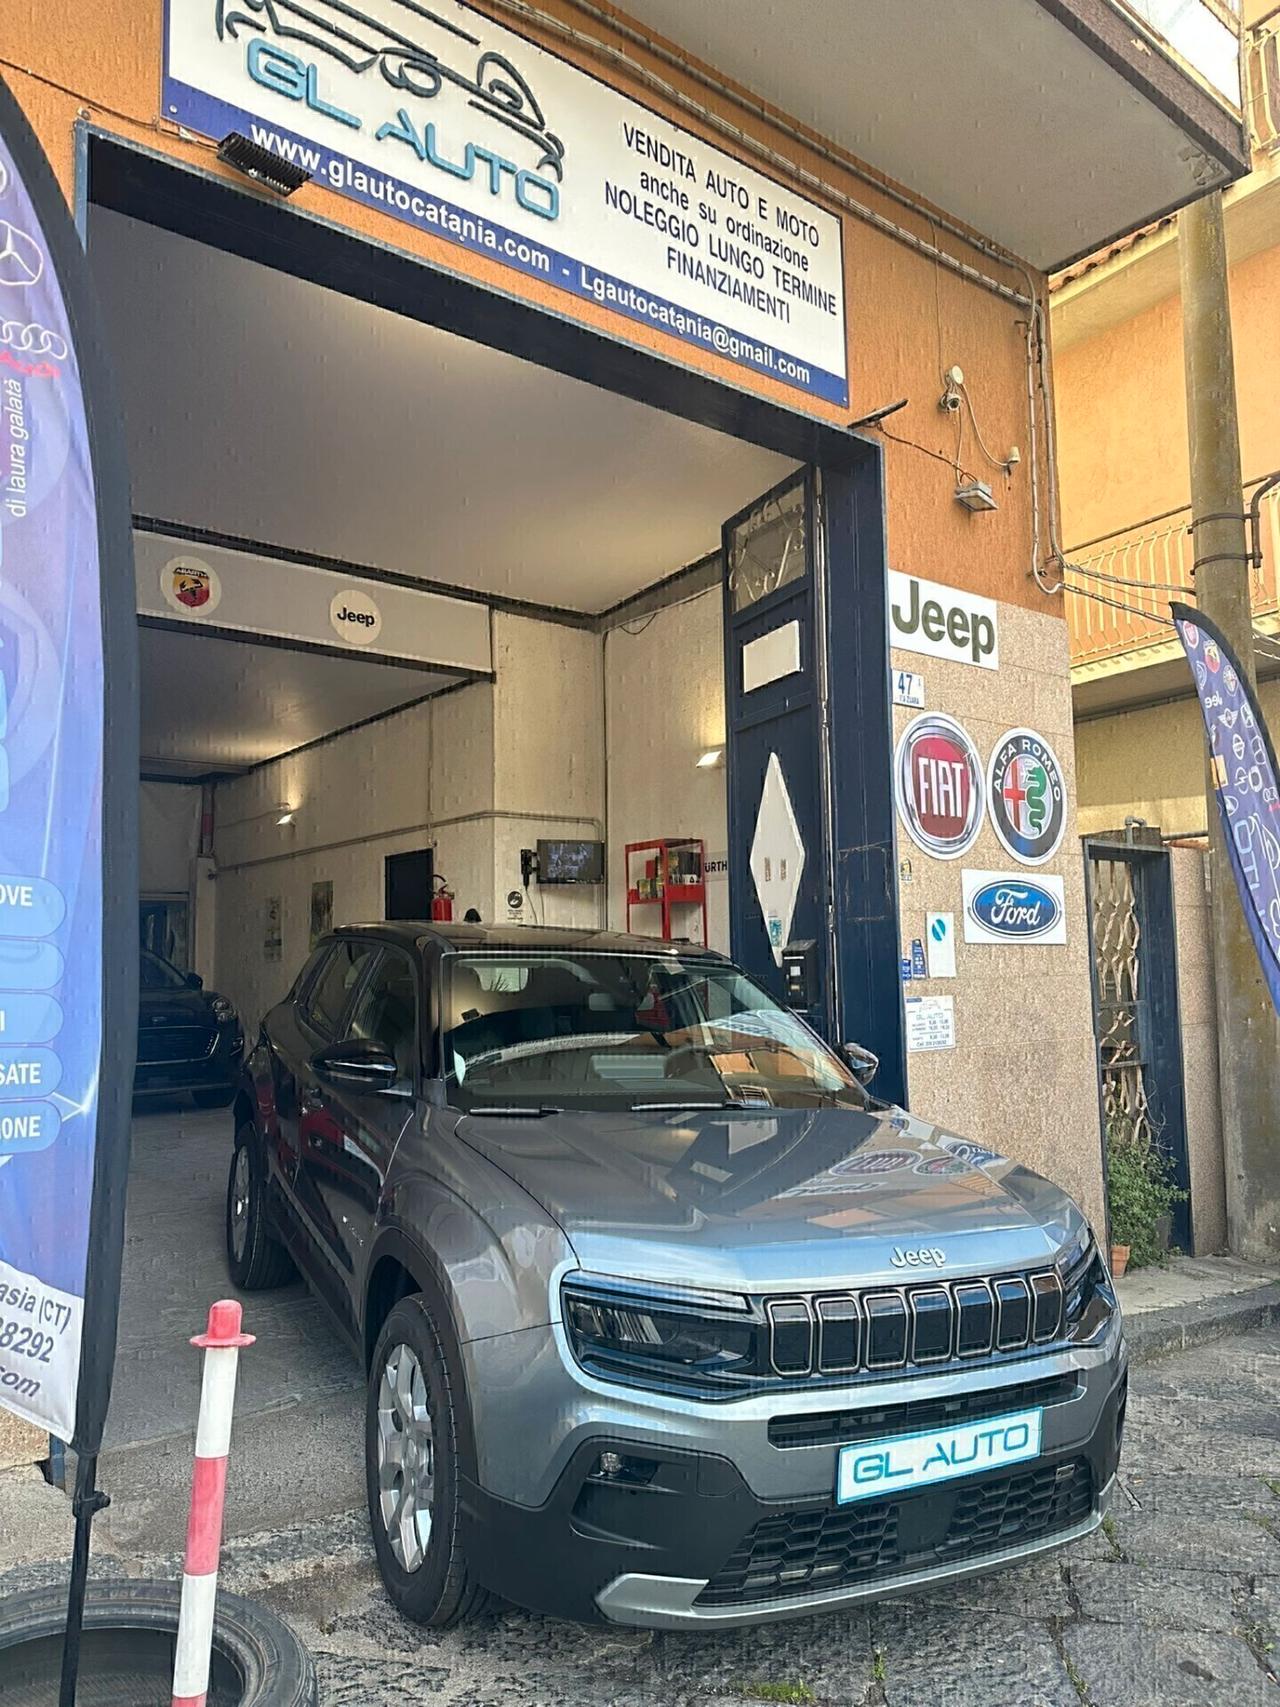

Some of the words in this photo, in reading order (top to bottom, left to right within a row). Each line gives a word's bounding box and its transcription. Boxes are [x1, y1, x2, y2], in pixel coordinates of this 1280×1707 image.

[246, 38, 362, 130] GL
[375, 108, 560, 221] AUTO
[623, 121, 697, 183] VENDITA
[705, 169, 749, 211] AUTO
[758, 198, 768, 220] E
[776, 207, 819, 248] MOTO
[605, 181, 699, 248] NOLEGGIO
[708, 233, 765, 280] LUNGO
[773, 265, 837, 316] TERMINE
[639, 171, 689, 211] anche
[698, 203, 717, 225] su
[725, 217, 809, 272] ordinazione
[250, 124, 551, 273] www.glautocatania.com
[581, 266, 811, 385] Lgautocatania@gmail.com
[667, 246, 791, 323] FINANZIAMENTI
[4, 379, 28, 440] galatà
[5, 443, 26, 493] laura
[5, 499, 27, 517] di
[336, 607, 376, 628] Jeep
[891, 579, 995, 663] Jeep
[898, 672, 913, 695] 47
[918, 757, 964, 818] FIAT
[993, 743, 1017, 795] ALFA
[1022, 738, 1062, 801] ROMEO
[704, 861, 728, 873] ÜRTH
[990, 888, 1041, 926] Ford
[890, 1246, 946, 1267] Jeep
[39, 1295, 72, 1335] (CT)
[853, 1451, 914, 1484] GL
[922, 1423, 1029, 1471] AUTO
